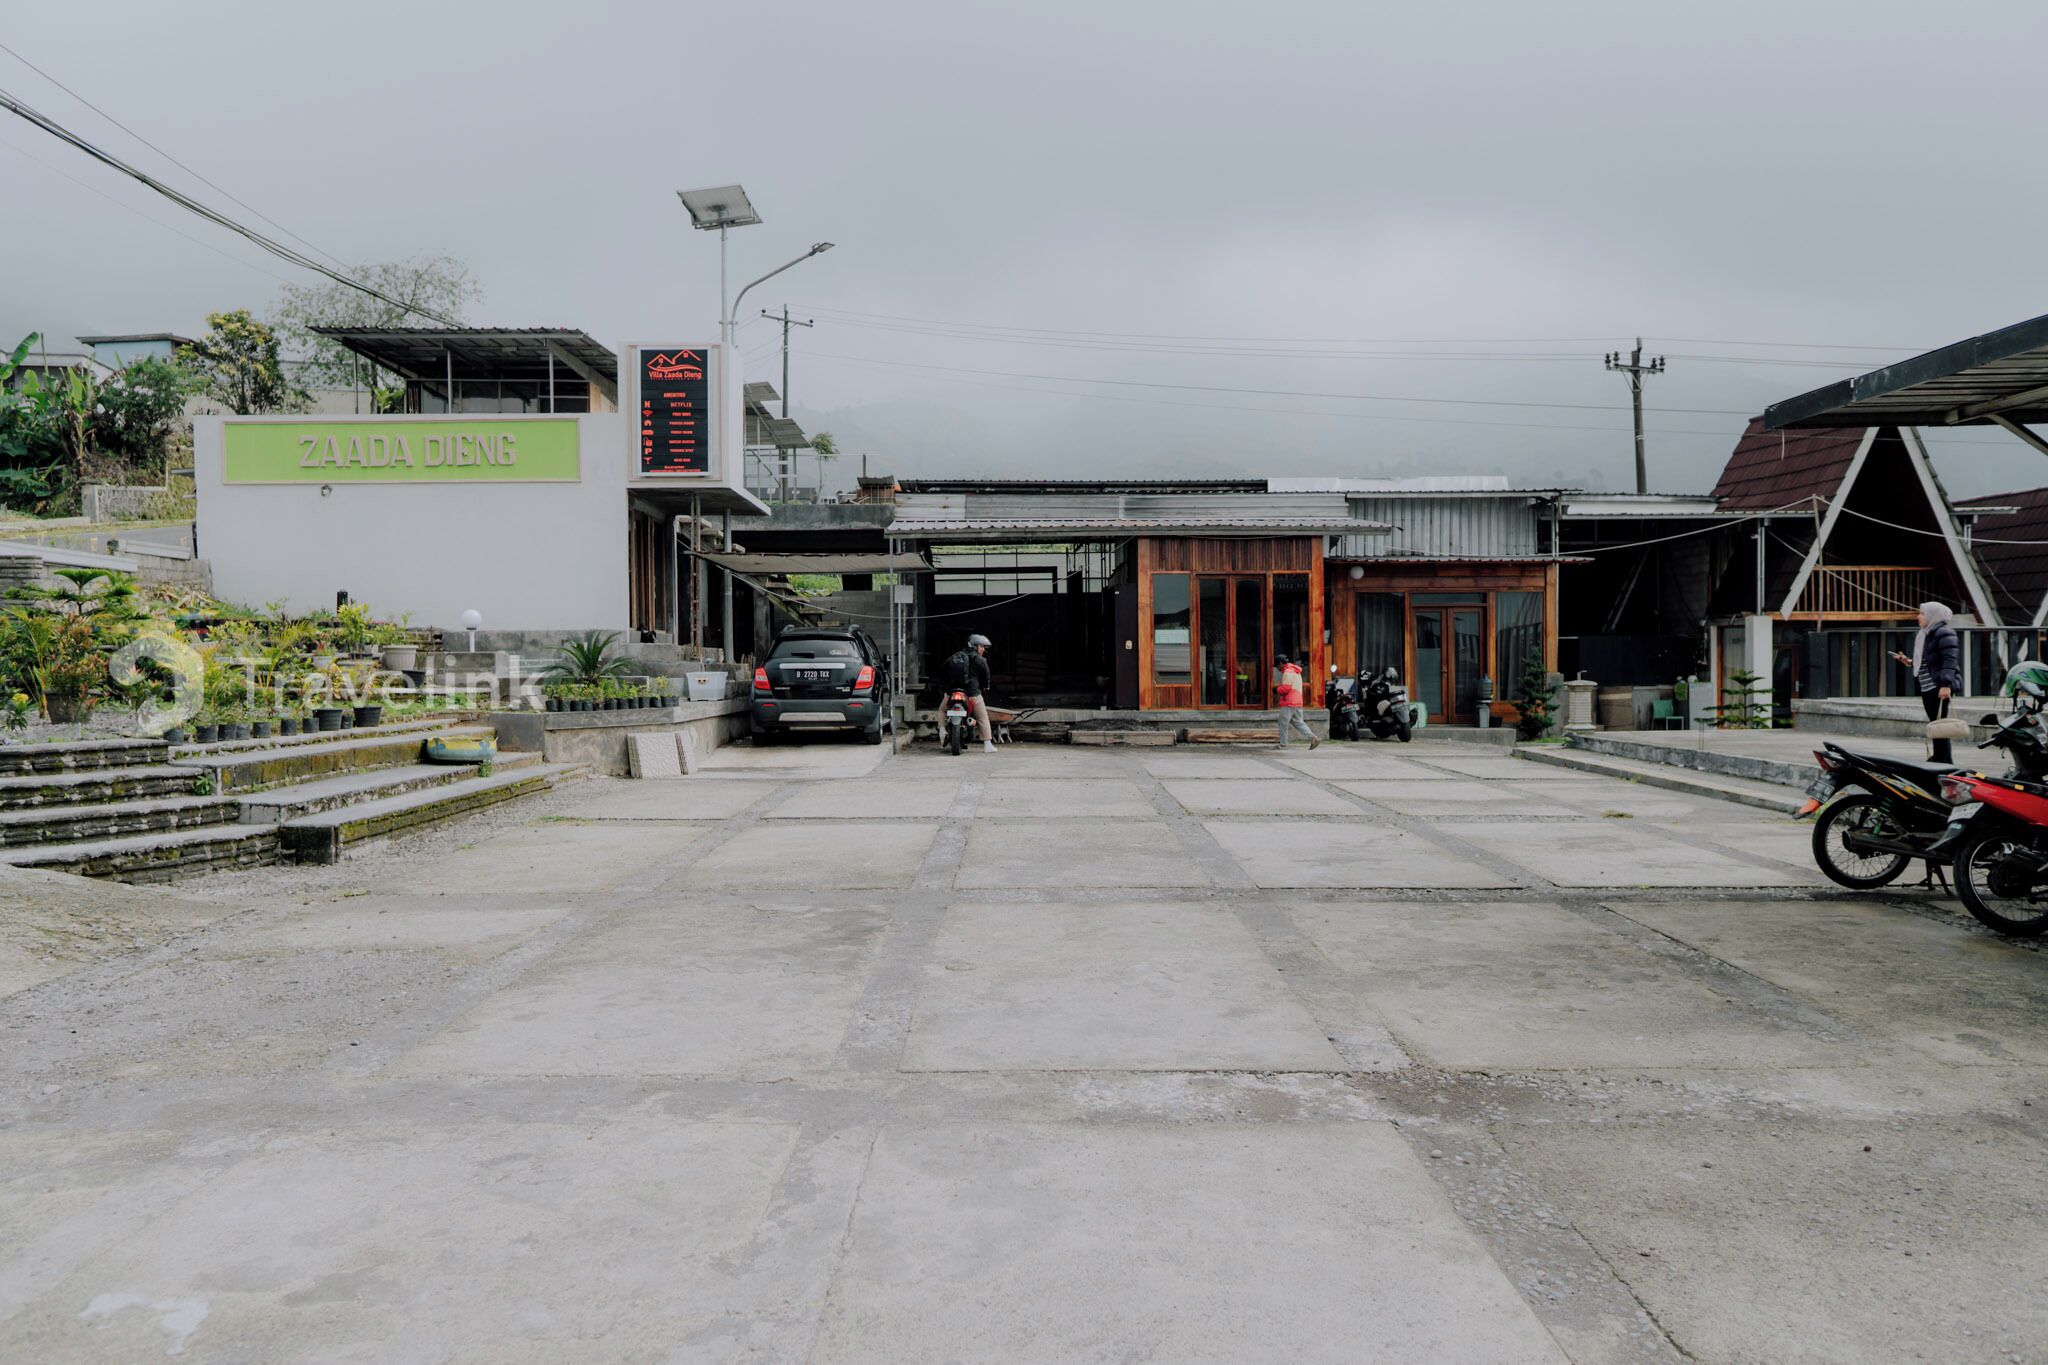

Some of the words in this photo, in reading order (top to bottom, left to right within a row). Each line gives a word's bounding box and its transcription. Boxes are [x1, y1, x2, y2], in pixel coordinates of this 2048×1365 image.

[648, 370, 663, 379] Villa
[664, 370, 683, 379] Zaada
[683, 370, 702, 380] Dieng
[299, 434, 414, 469] ZAADA
[423, 432, 517, 468] DIENG
[644, 447, 653, 455] P
